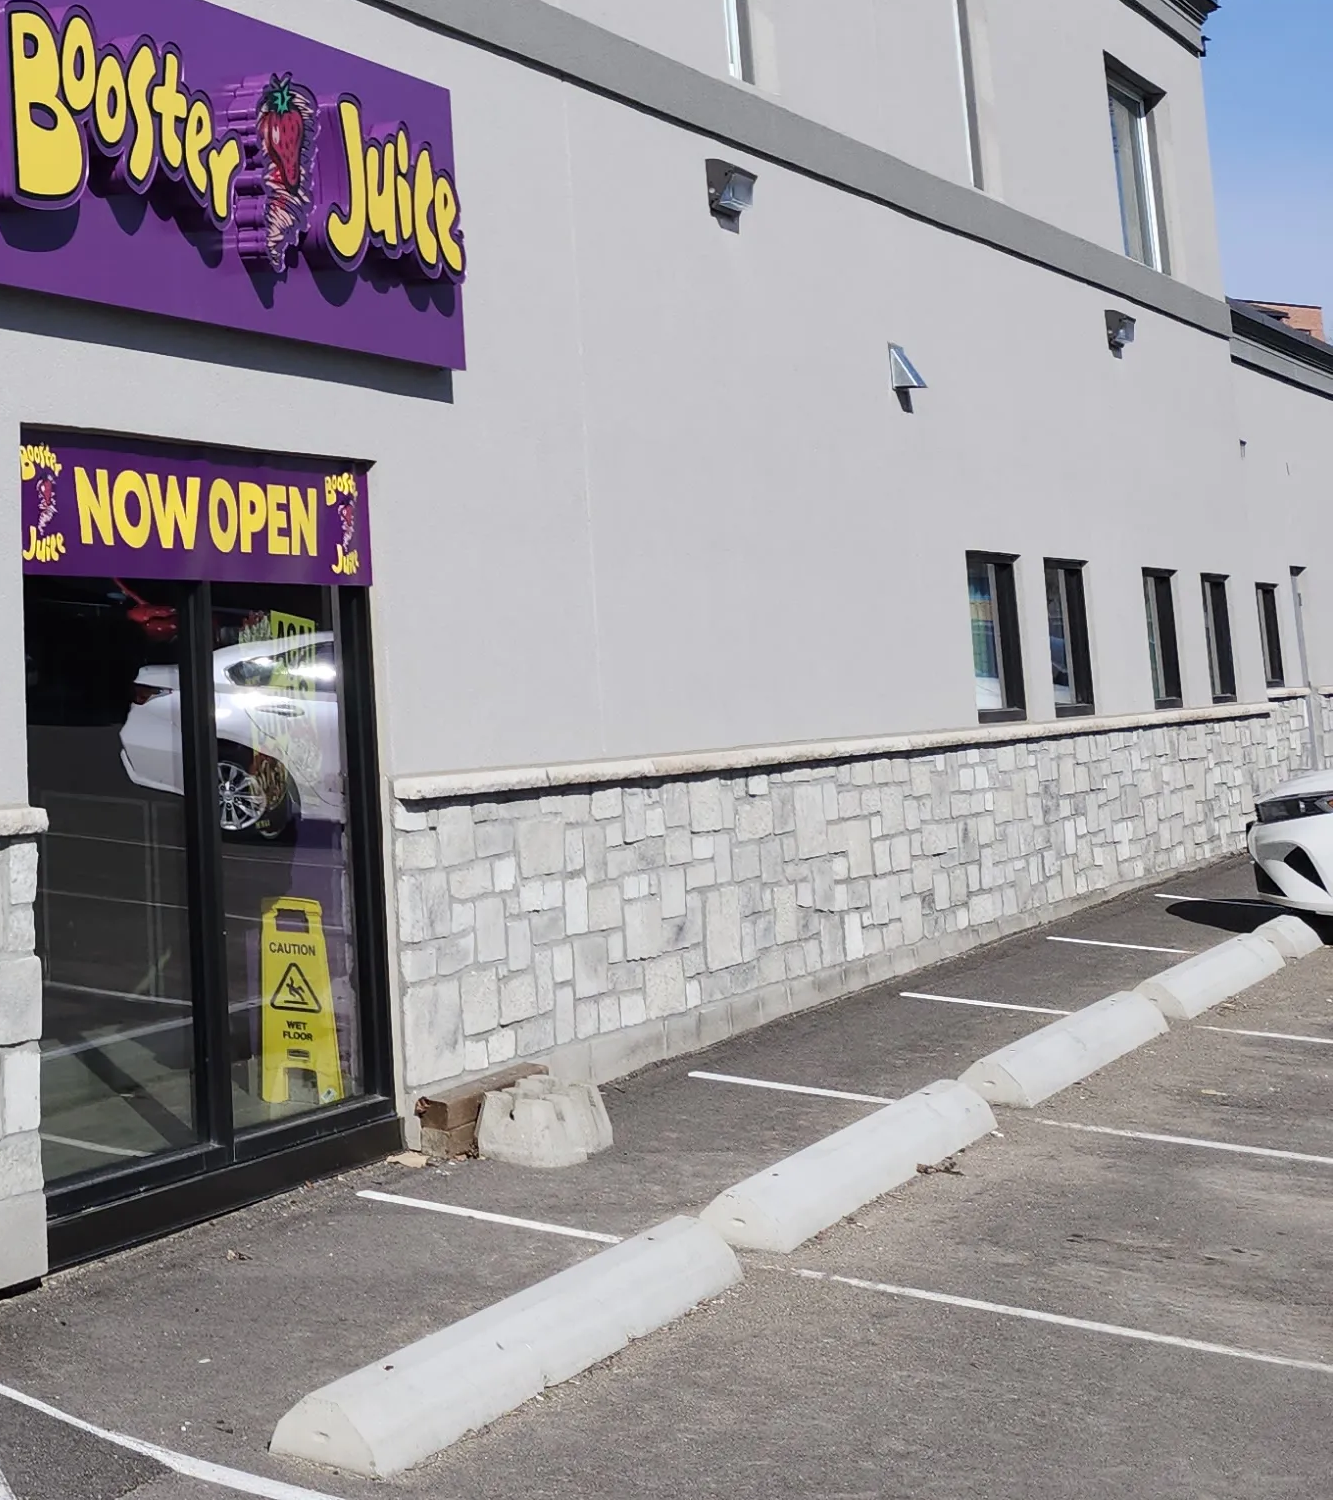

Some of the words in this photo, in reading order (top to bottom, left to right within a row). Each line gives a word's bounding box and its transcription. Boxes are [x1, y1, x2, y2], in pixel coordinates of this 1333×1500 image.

[11, 11, 240, 218] Booster
[328, 99, 463, 272] Juice
[325, 472, 358, 506] Boost
[74, 466, 201, 550] NOW
[208, 477, 318, 557] OPEN
[22, 525, 66, 562] Juice
[269, 941, 316, 956] CAUTION
[283, 1030, 314, 1042] FLOOR
[286, 1020, 308, 1031] WET
